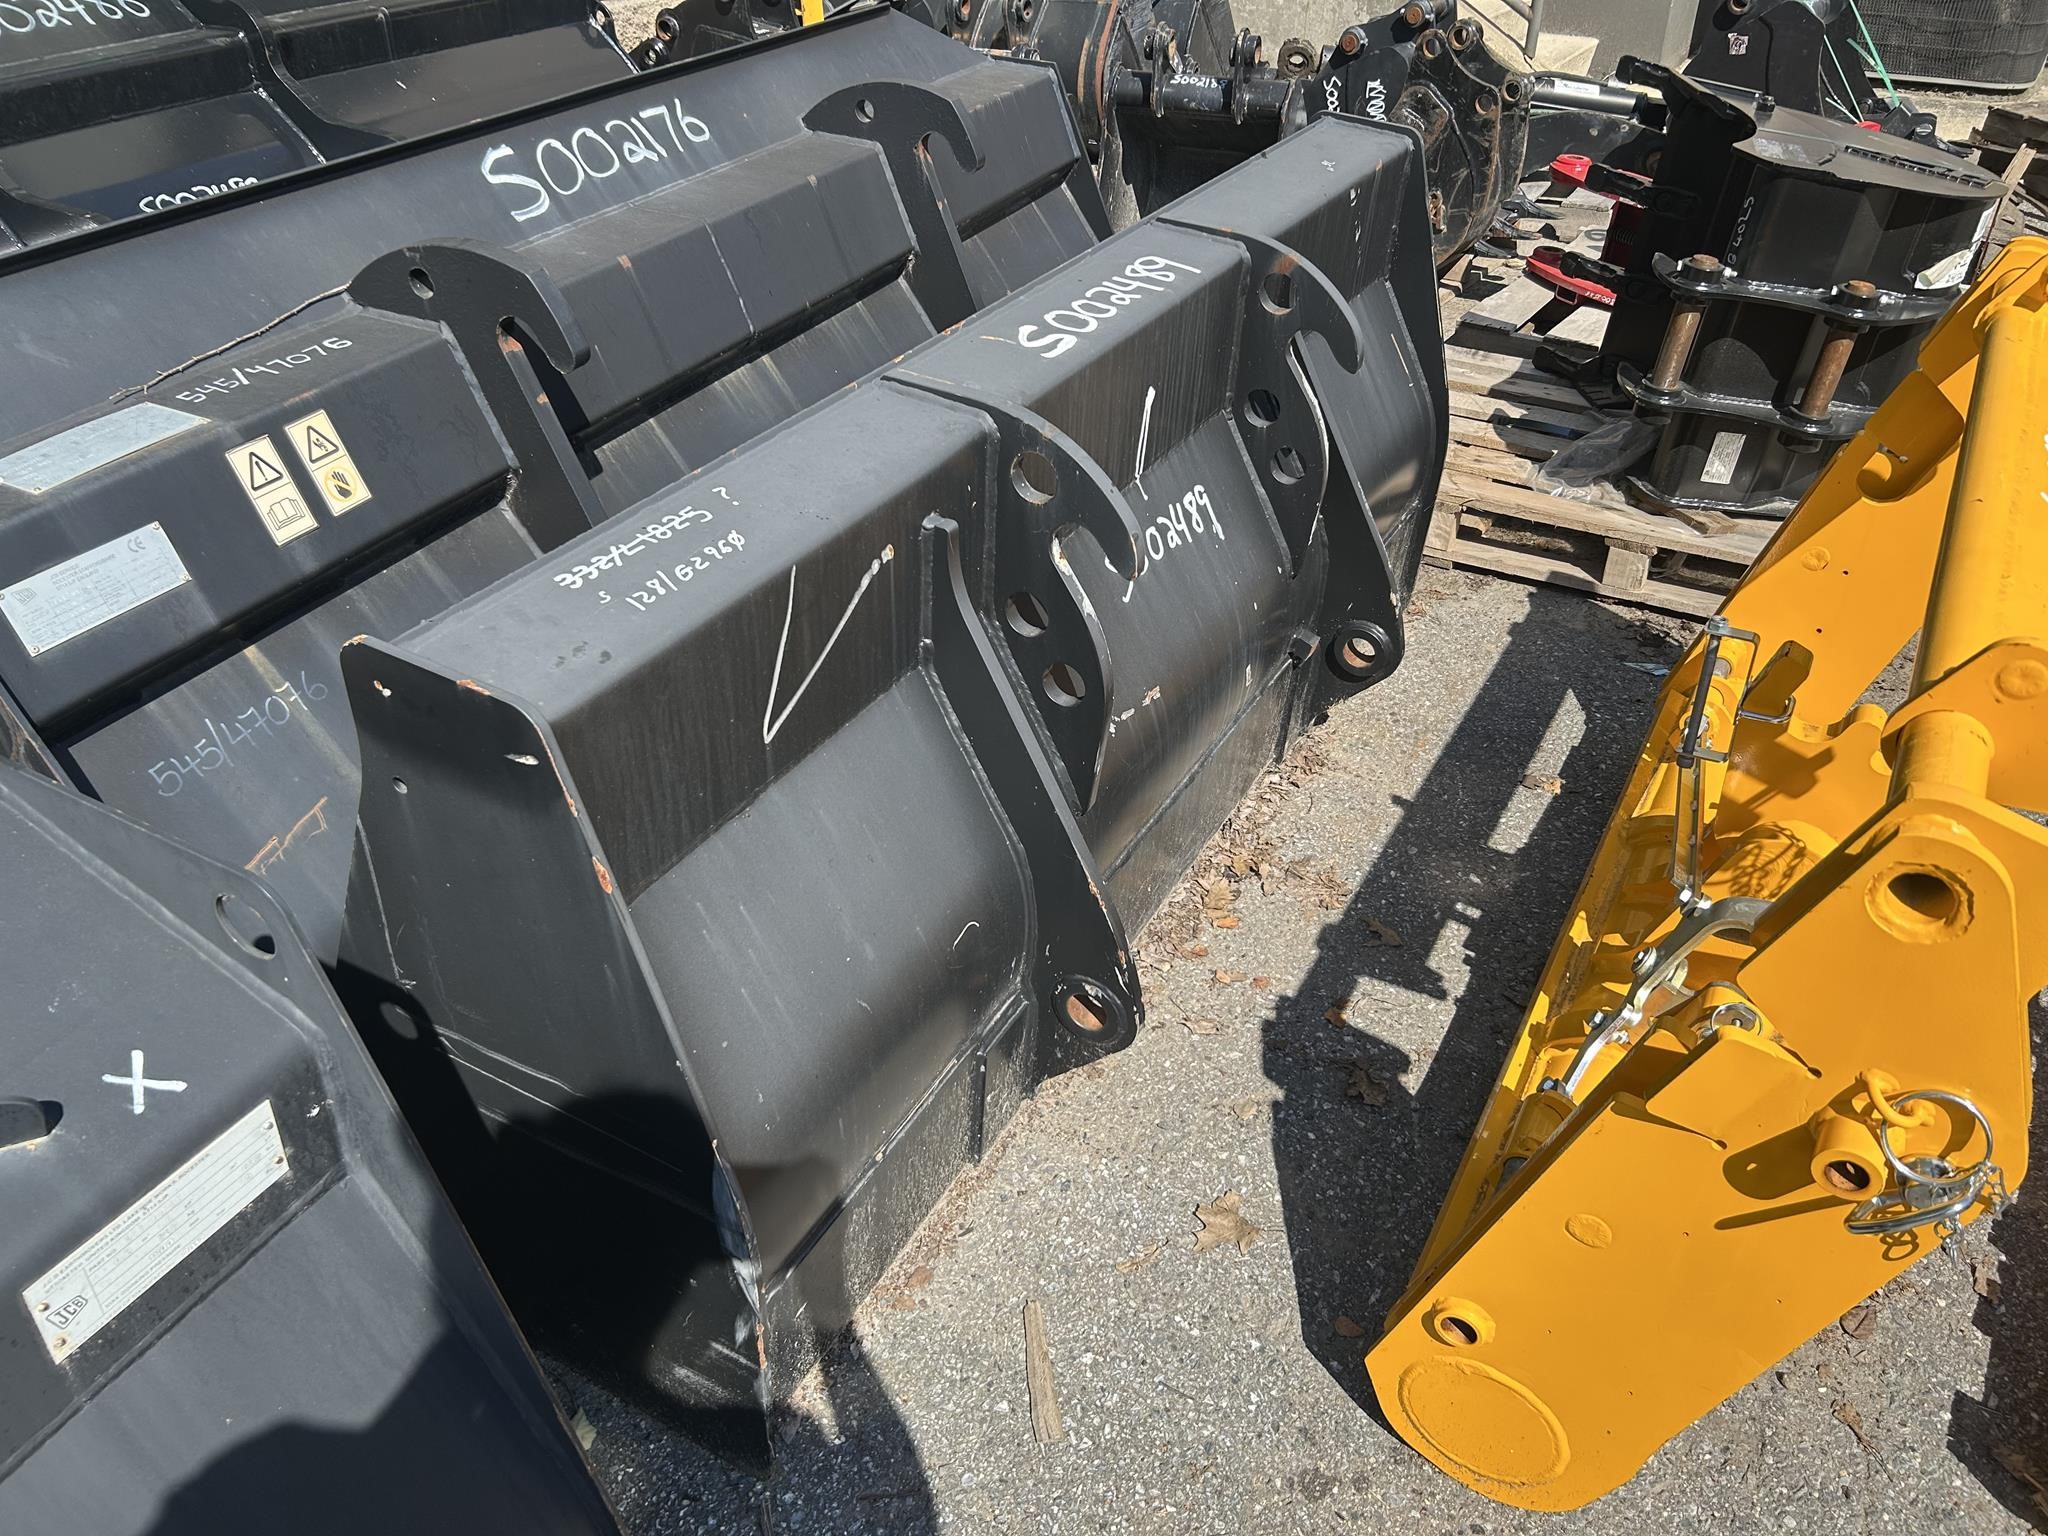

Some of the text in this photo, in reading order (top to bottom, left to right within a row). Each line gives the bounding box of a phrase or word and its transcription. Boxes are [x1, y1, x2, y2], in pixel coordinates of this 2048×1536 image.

[481, 97, 711, 222] S002176
[1018, 255, 1202, 359] S002489
[175, 337, 353, 403] 545/47076
[147, 671, 329, 798] 545/47076
[55, 1297, 87, 1327] JCB
